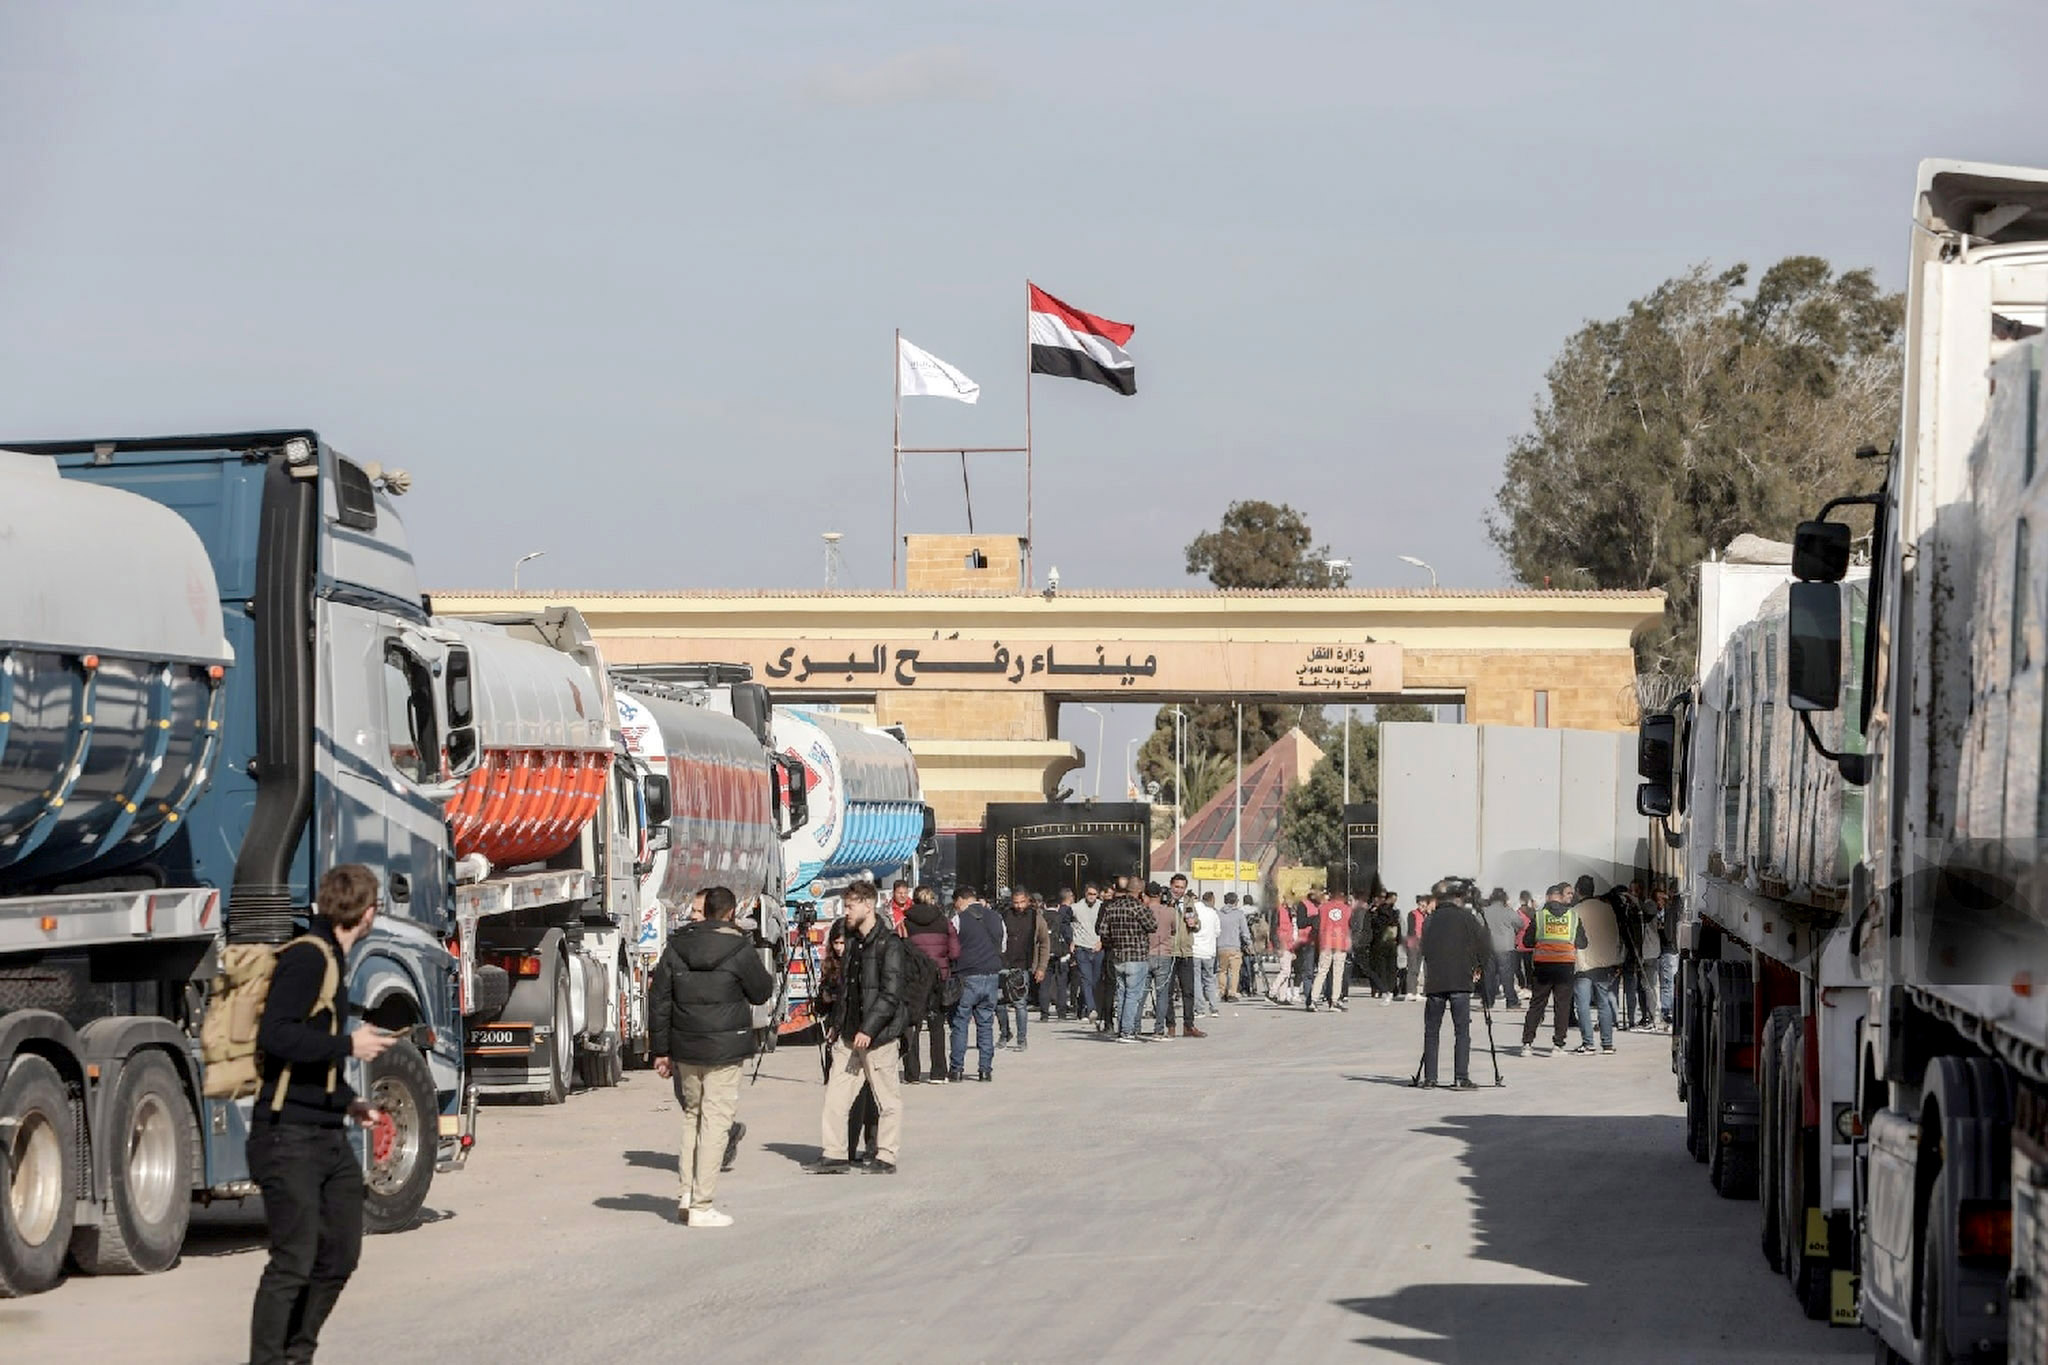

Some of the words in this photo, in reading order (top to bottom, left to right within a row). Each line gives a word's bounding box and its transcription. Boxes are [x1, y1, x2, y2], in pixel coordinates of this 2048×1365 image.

[1307, 646, 1333, 662] النقل
[1337, 646, 1364, 662] وزارة
[895, 640, 1025, 686] رفح
[1031, 644, 1157, 686] ميناء
[470, 1031, 513, 1043] F2000
